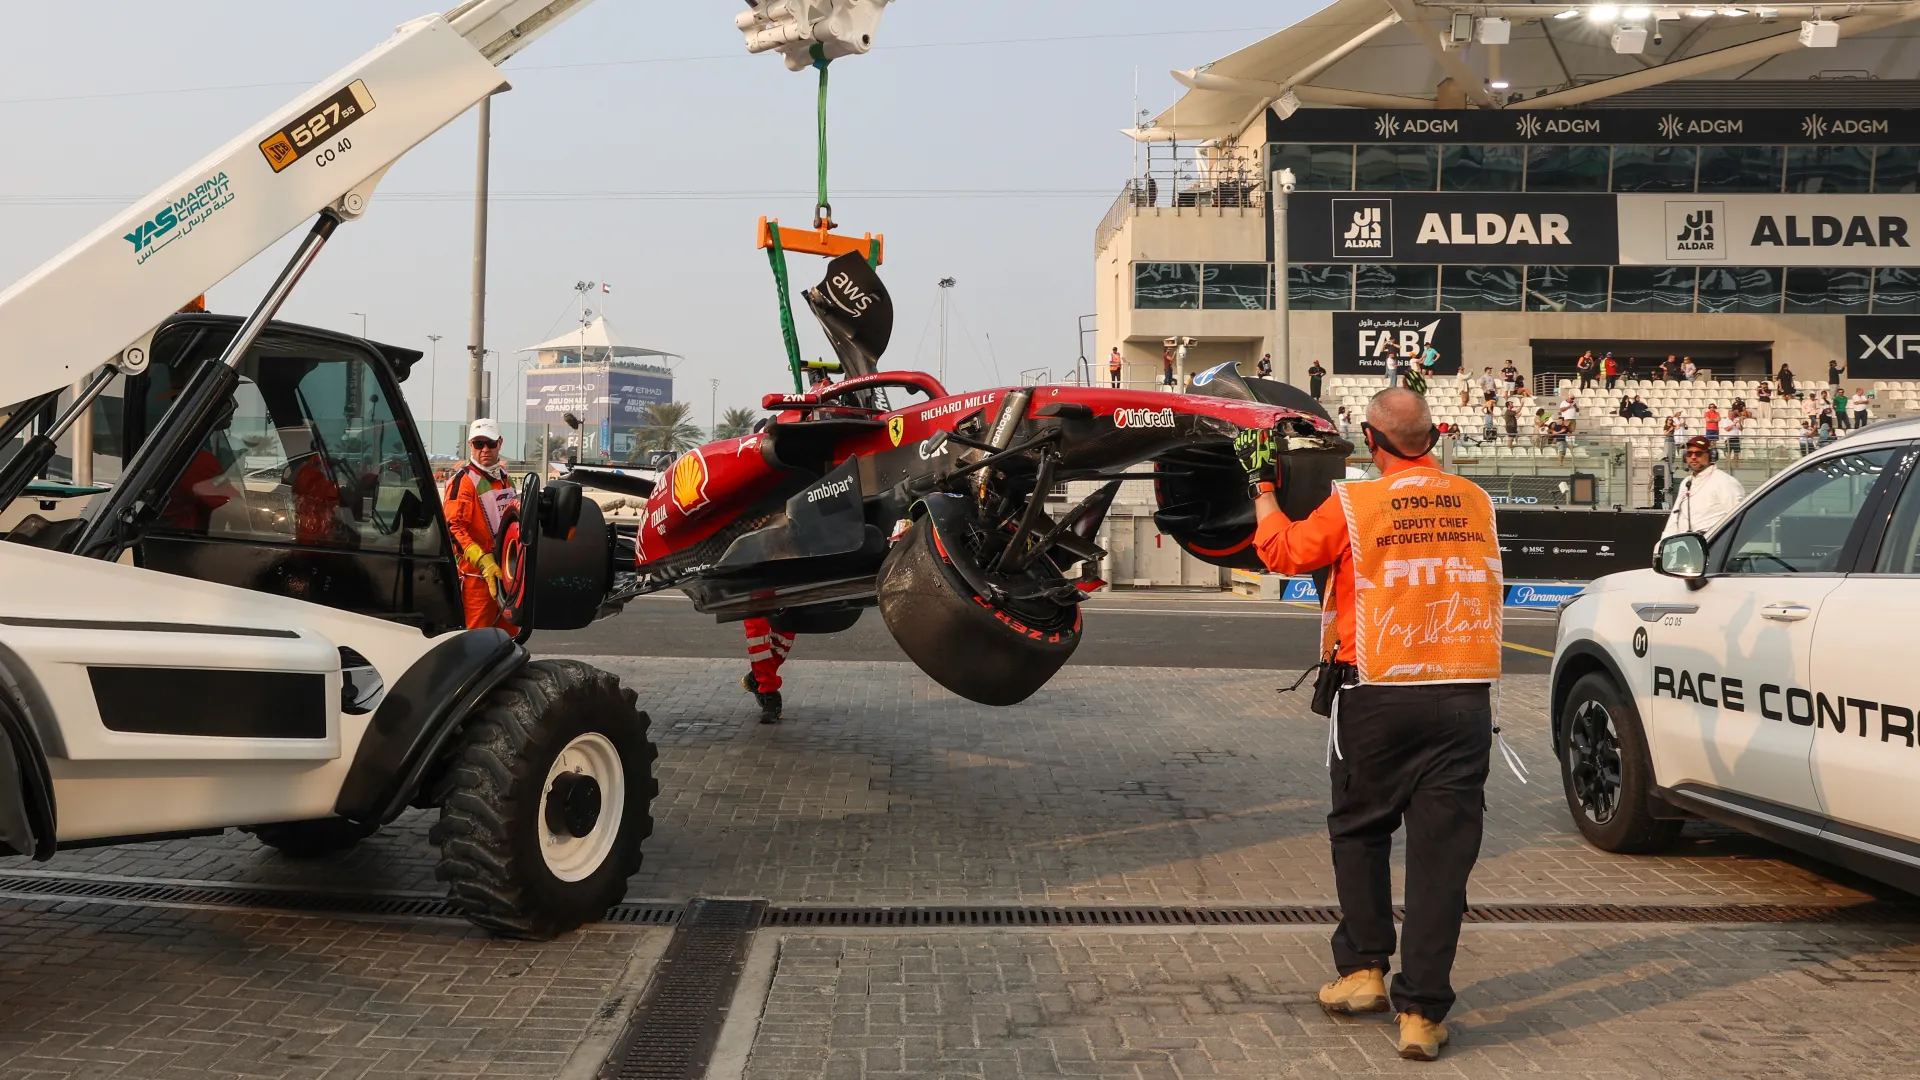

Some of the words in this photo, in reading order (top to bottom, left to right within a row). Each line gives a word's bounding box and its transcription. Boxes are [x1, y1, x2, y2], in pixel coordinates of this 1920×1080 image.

[290, 102, 340, 147] 527
[341, 105, 356, 118] 55
[1403, 119, 1459, 133] ADGM
[1545, 119, 1600, 133] ADGM
[1687, 119, 1743, 133] ADGM
[1831, 119, 1888, 134] ADGM
[269, 142, 289, 161] JCB
[315, 149, 336, 167] CO
[338, 138, 352, 153] 40
[173, 171, 228, 212] MARINA
[177, 179, 229, 222] CIRCUIT
[213, 192, 235, 211] حلبة
[123, 205, 178, 253] YAS
[1416, 213, 1572, 244] ALDAR
[1750, 216, 1911, 247] ALDAR
[1344, 240, 1381, 248] ALDAR
[1677, 242, 1714, 250] ALDAR
[832, 272, 872, 310] aws
[838, 374, 878, 389] TECHNOLOGY
[635, 387, 661, 395] ETIHAD
[783, 394, 806, 402] ZYN
[921, 401, 961, 422] RICHARD
[964, 393, 996, 409] MILLE
[1126, 408, 1175, 427] UniCredit
[1391, 495, 1461, 510] 0790-ABU
[651, 504, 669, 529] ITALIA
[1393, 518, 1436, 530] DEPUTY
[1439, 517, 1469, 528] CHIEF
[1154, 533, 1162, 549] 1
[1376, 533, 1434, 547] RECOVERY
[1436, 531, 1486, 543] MARSHAL
[1560, 547, 1588, 555] crypto.com
[1445, 556, 1475, 570] ALL
[1384, 557, 1443, 588] PIT
[1445, 569, 1487, 583] TIME
[1515, 586, 1572, 604] Paramou
[1373, 605, 1422, 656] Yas
[1418, 591, 1494, 645] Island
[1664, 616, 1674, 626] CO
[1674, 617, 1682, 627] 05
[1635, 633, 1646, 651] 01
[1653, 665, 1745, 713] RACE
[1759, 683, 1920, 748] CONTR
